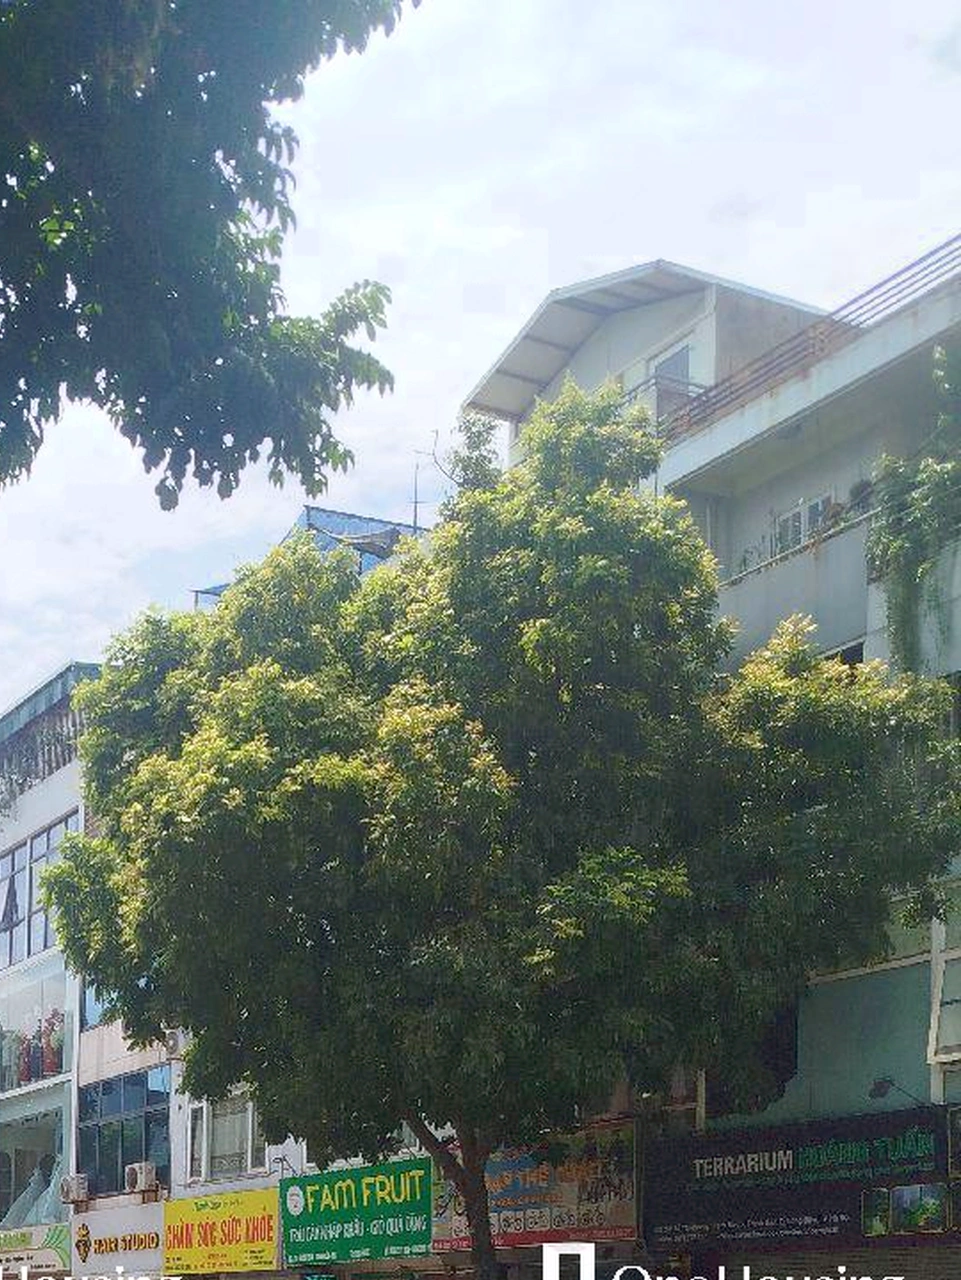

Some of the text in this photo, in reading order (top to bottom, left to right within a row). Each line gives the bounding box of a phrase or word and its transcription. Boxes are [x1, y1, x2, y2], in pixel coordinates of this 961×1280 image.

[693, 1149, 793, 1178] TERRARIUM
[306, 1169, 425, 1213] FAM FRUIT
[93, 1231, 160, 1254] HAIR STUDIO
